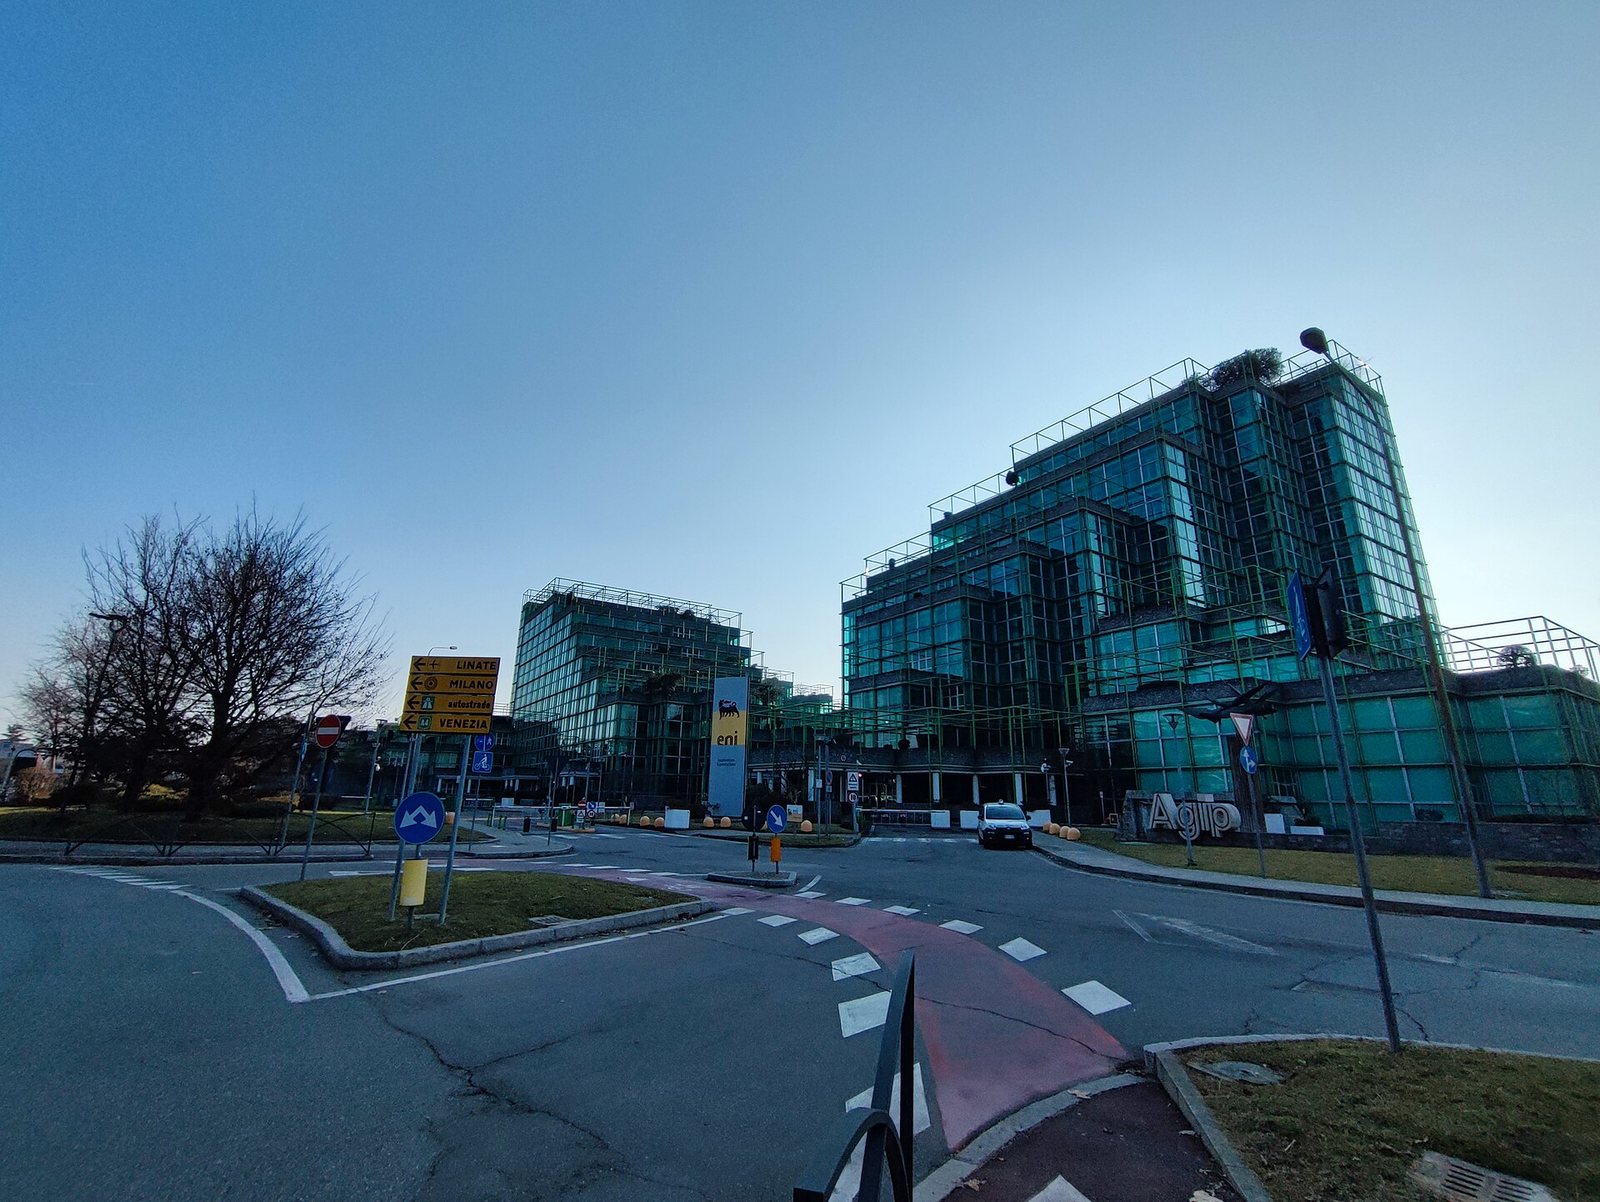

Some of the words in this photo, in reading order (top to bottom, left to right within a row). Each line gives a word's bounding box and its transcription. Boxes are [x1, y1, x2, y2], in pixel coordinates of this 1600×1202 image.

[456, 661, 496, 670] LINATE
[449, 680, 494, 689] MILANO
[448, 699, 490, 709] autostrade
[440, 718, 488, 729] VENEZIA
[717, 730, 738, 746] eni
[1151, 793, 1240, 841] Agip
